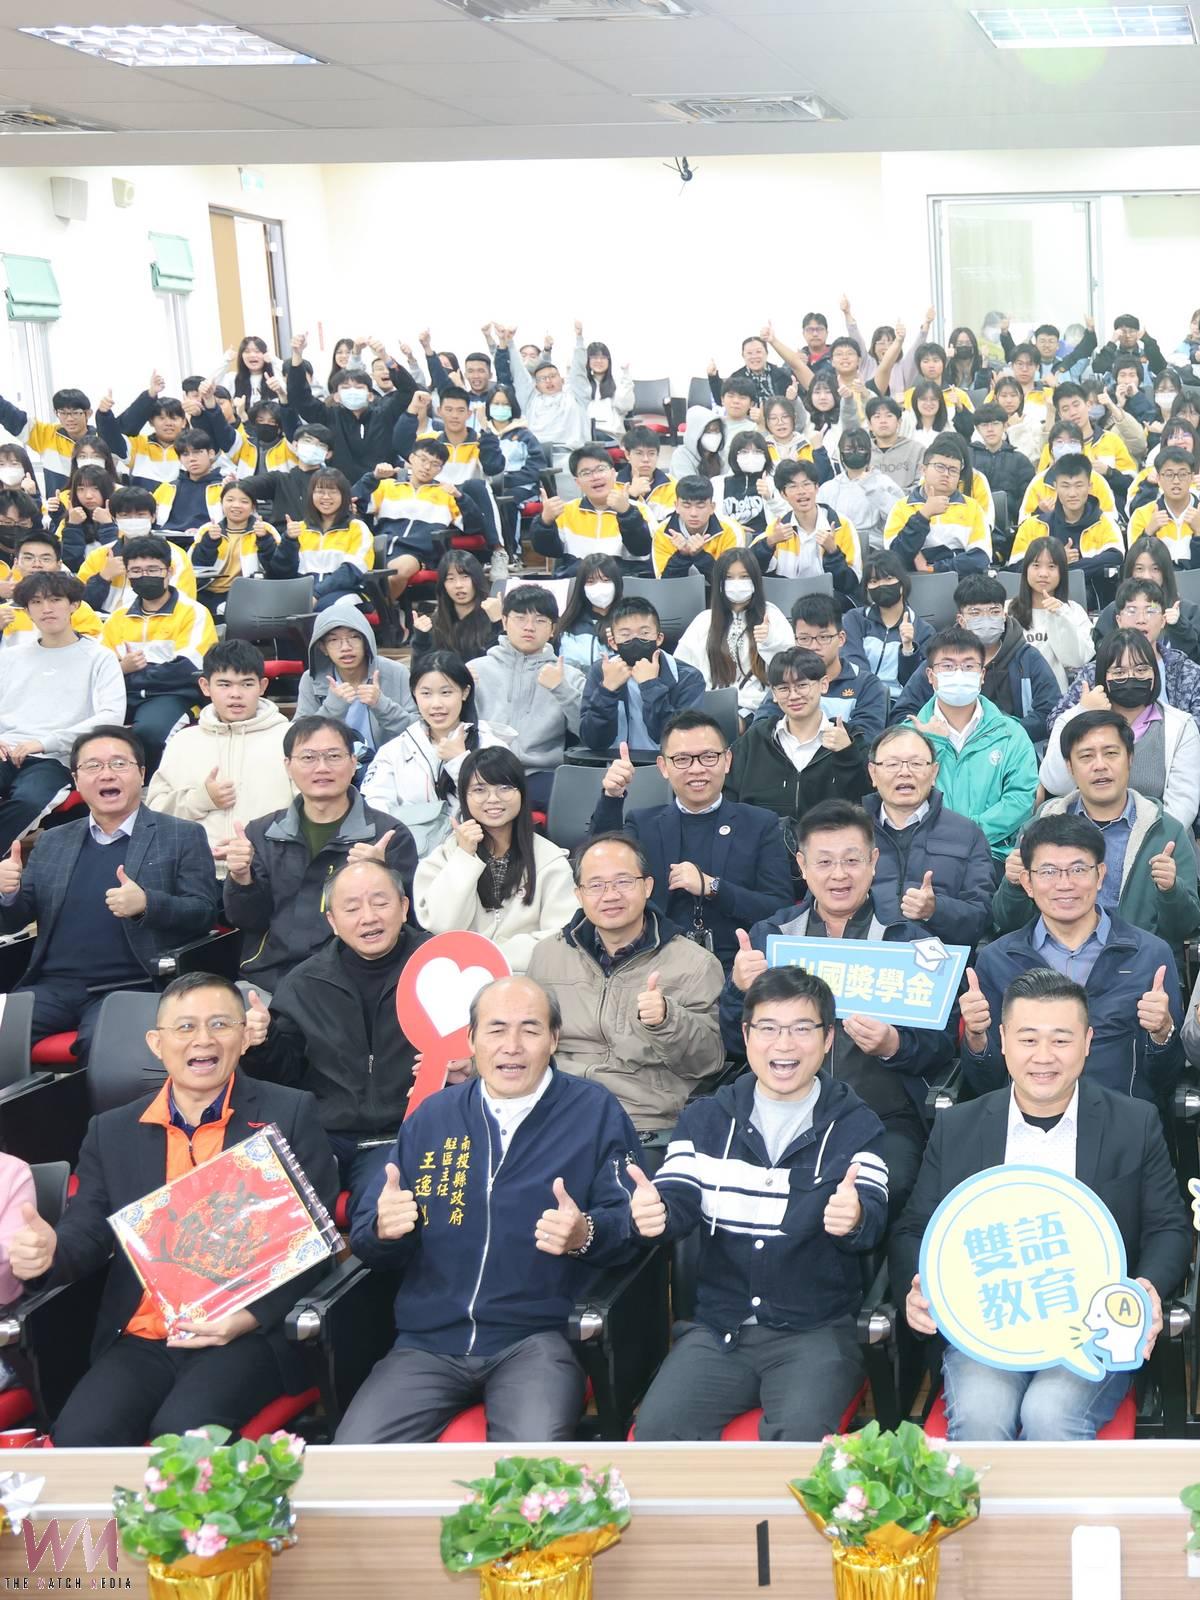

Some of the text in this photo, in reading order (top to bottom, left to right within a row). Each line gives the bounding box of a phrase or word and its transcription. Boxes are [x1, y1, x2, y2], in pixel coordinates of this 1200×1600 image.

[436, 1137, 458, 1197] 駐區主任
[448, 1135, 471, 1226] 南投縣政府
[963, 1211, 1071, 1278] 雙語
[978, 1268, 1080, 1332] 教育
[1119, 1297, 1131, 1316] A
